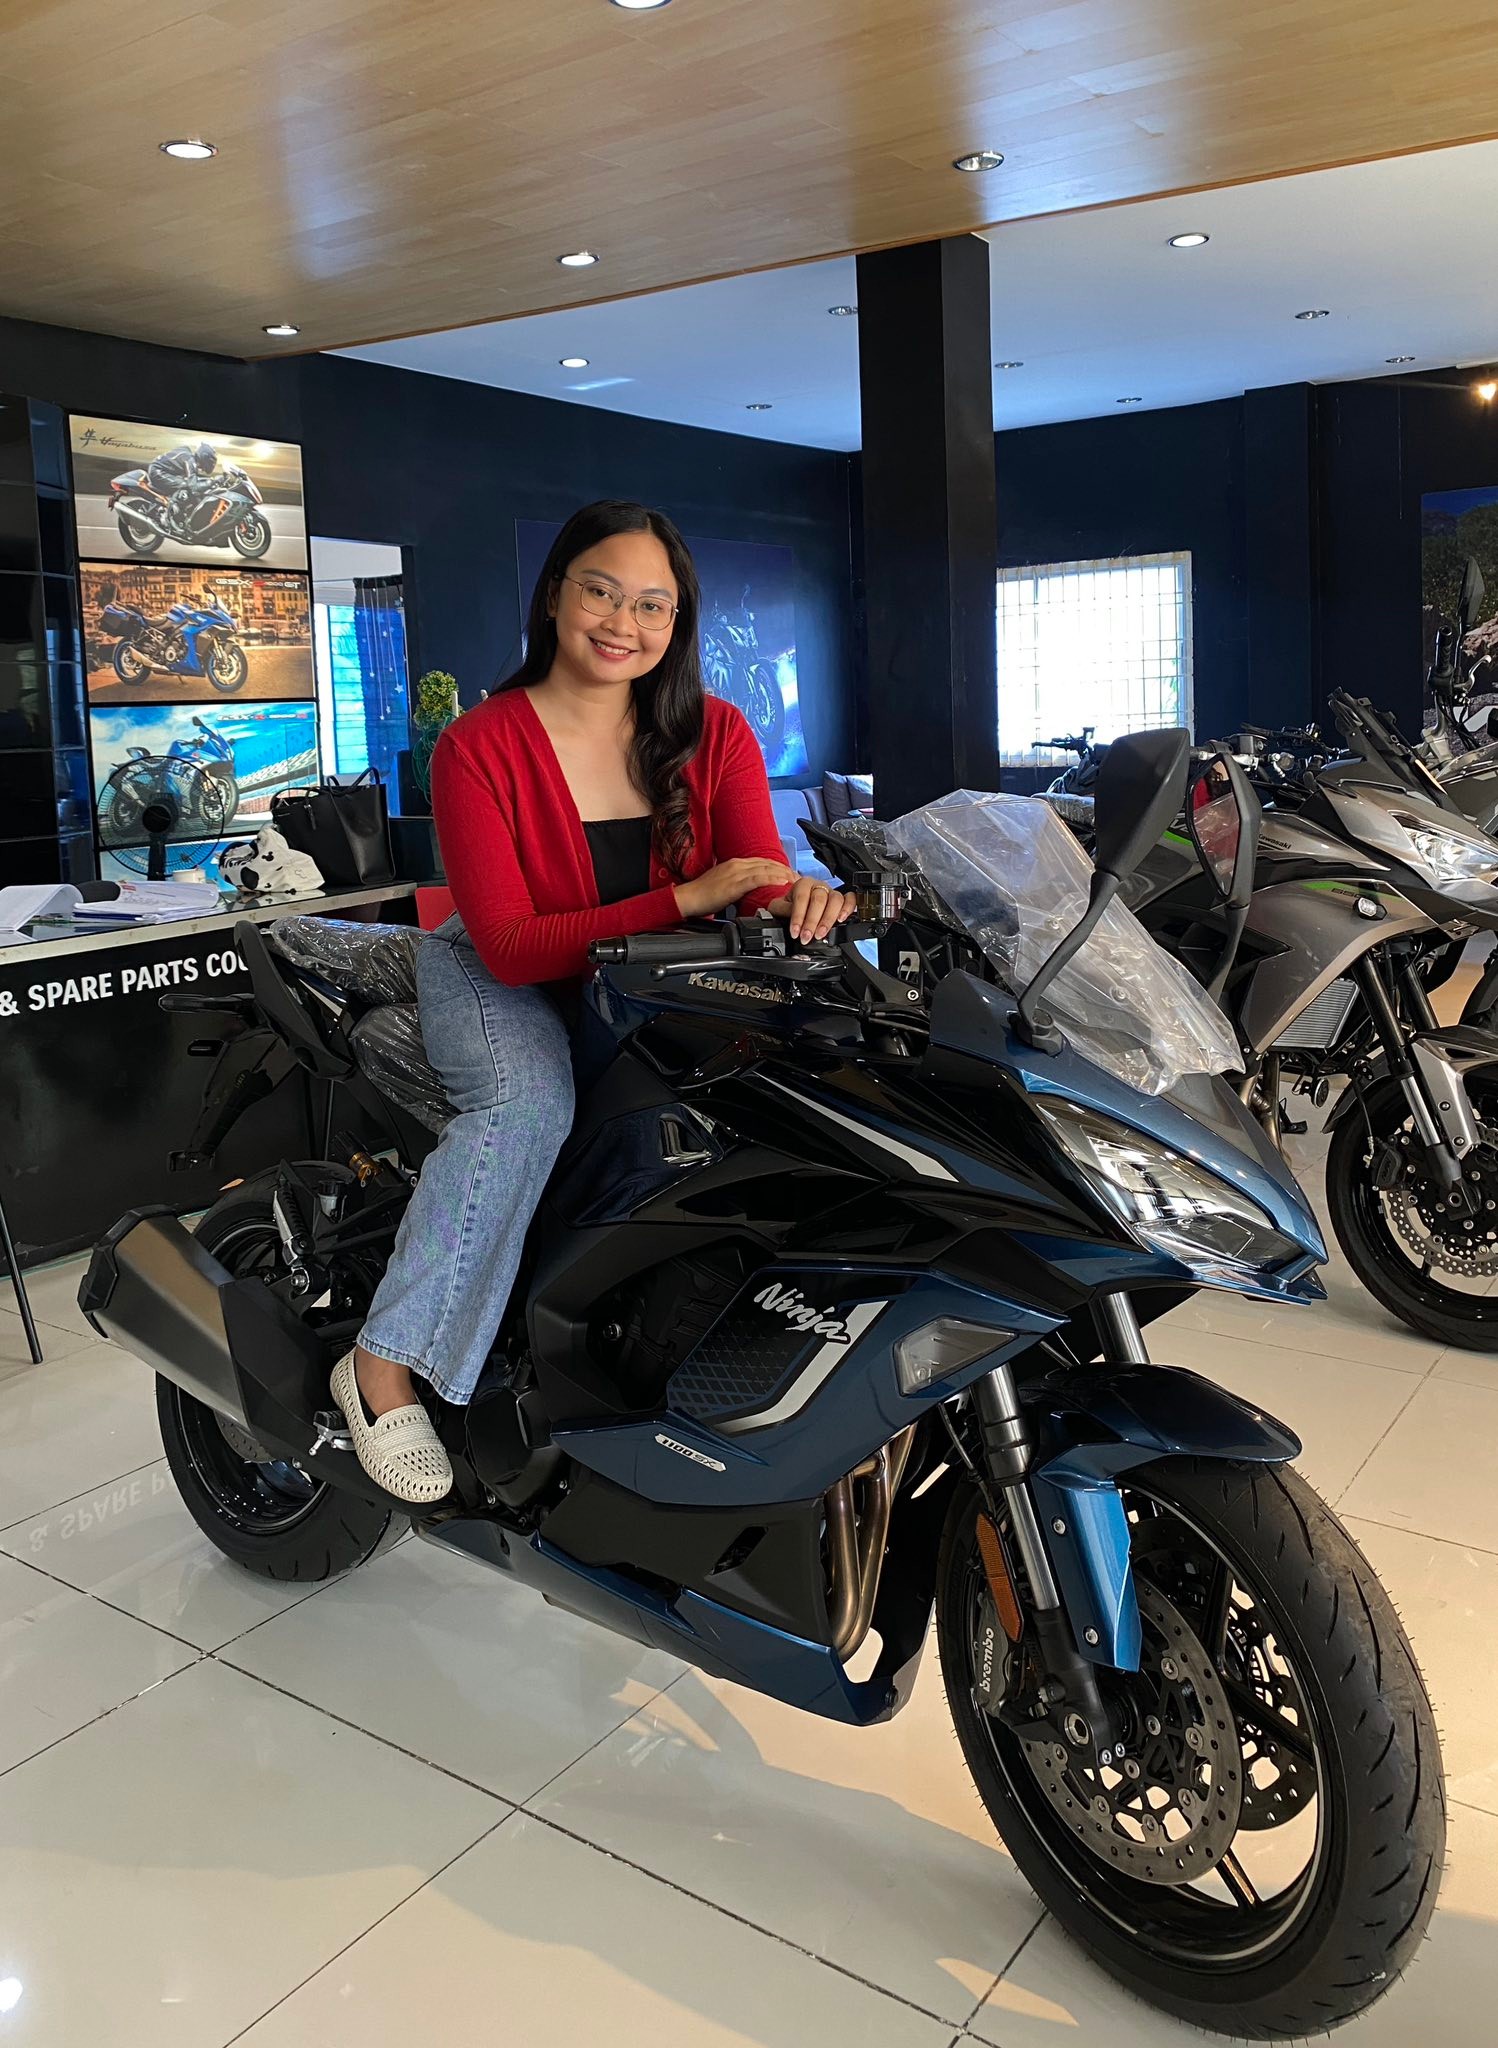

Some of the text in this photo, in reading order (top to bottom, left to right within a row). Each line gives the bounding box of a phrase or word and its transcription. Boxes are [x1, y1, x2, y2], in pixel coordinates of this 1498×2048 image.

[0, 991, 20, 1017] &
[28, 972, 113, 1011] SPARE
[121, 957, 199, 994] PARTS
[687, 972, 787, 1004] Kawasak
[753, 1282, 848, 1341] Ninja
[662, 1439, 716, 1467] 1100 SX
[979, 1627, 994, 1692] brembo
